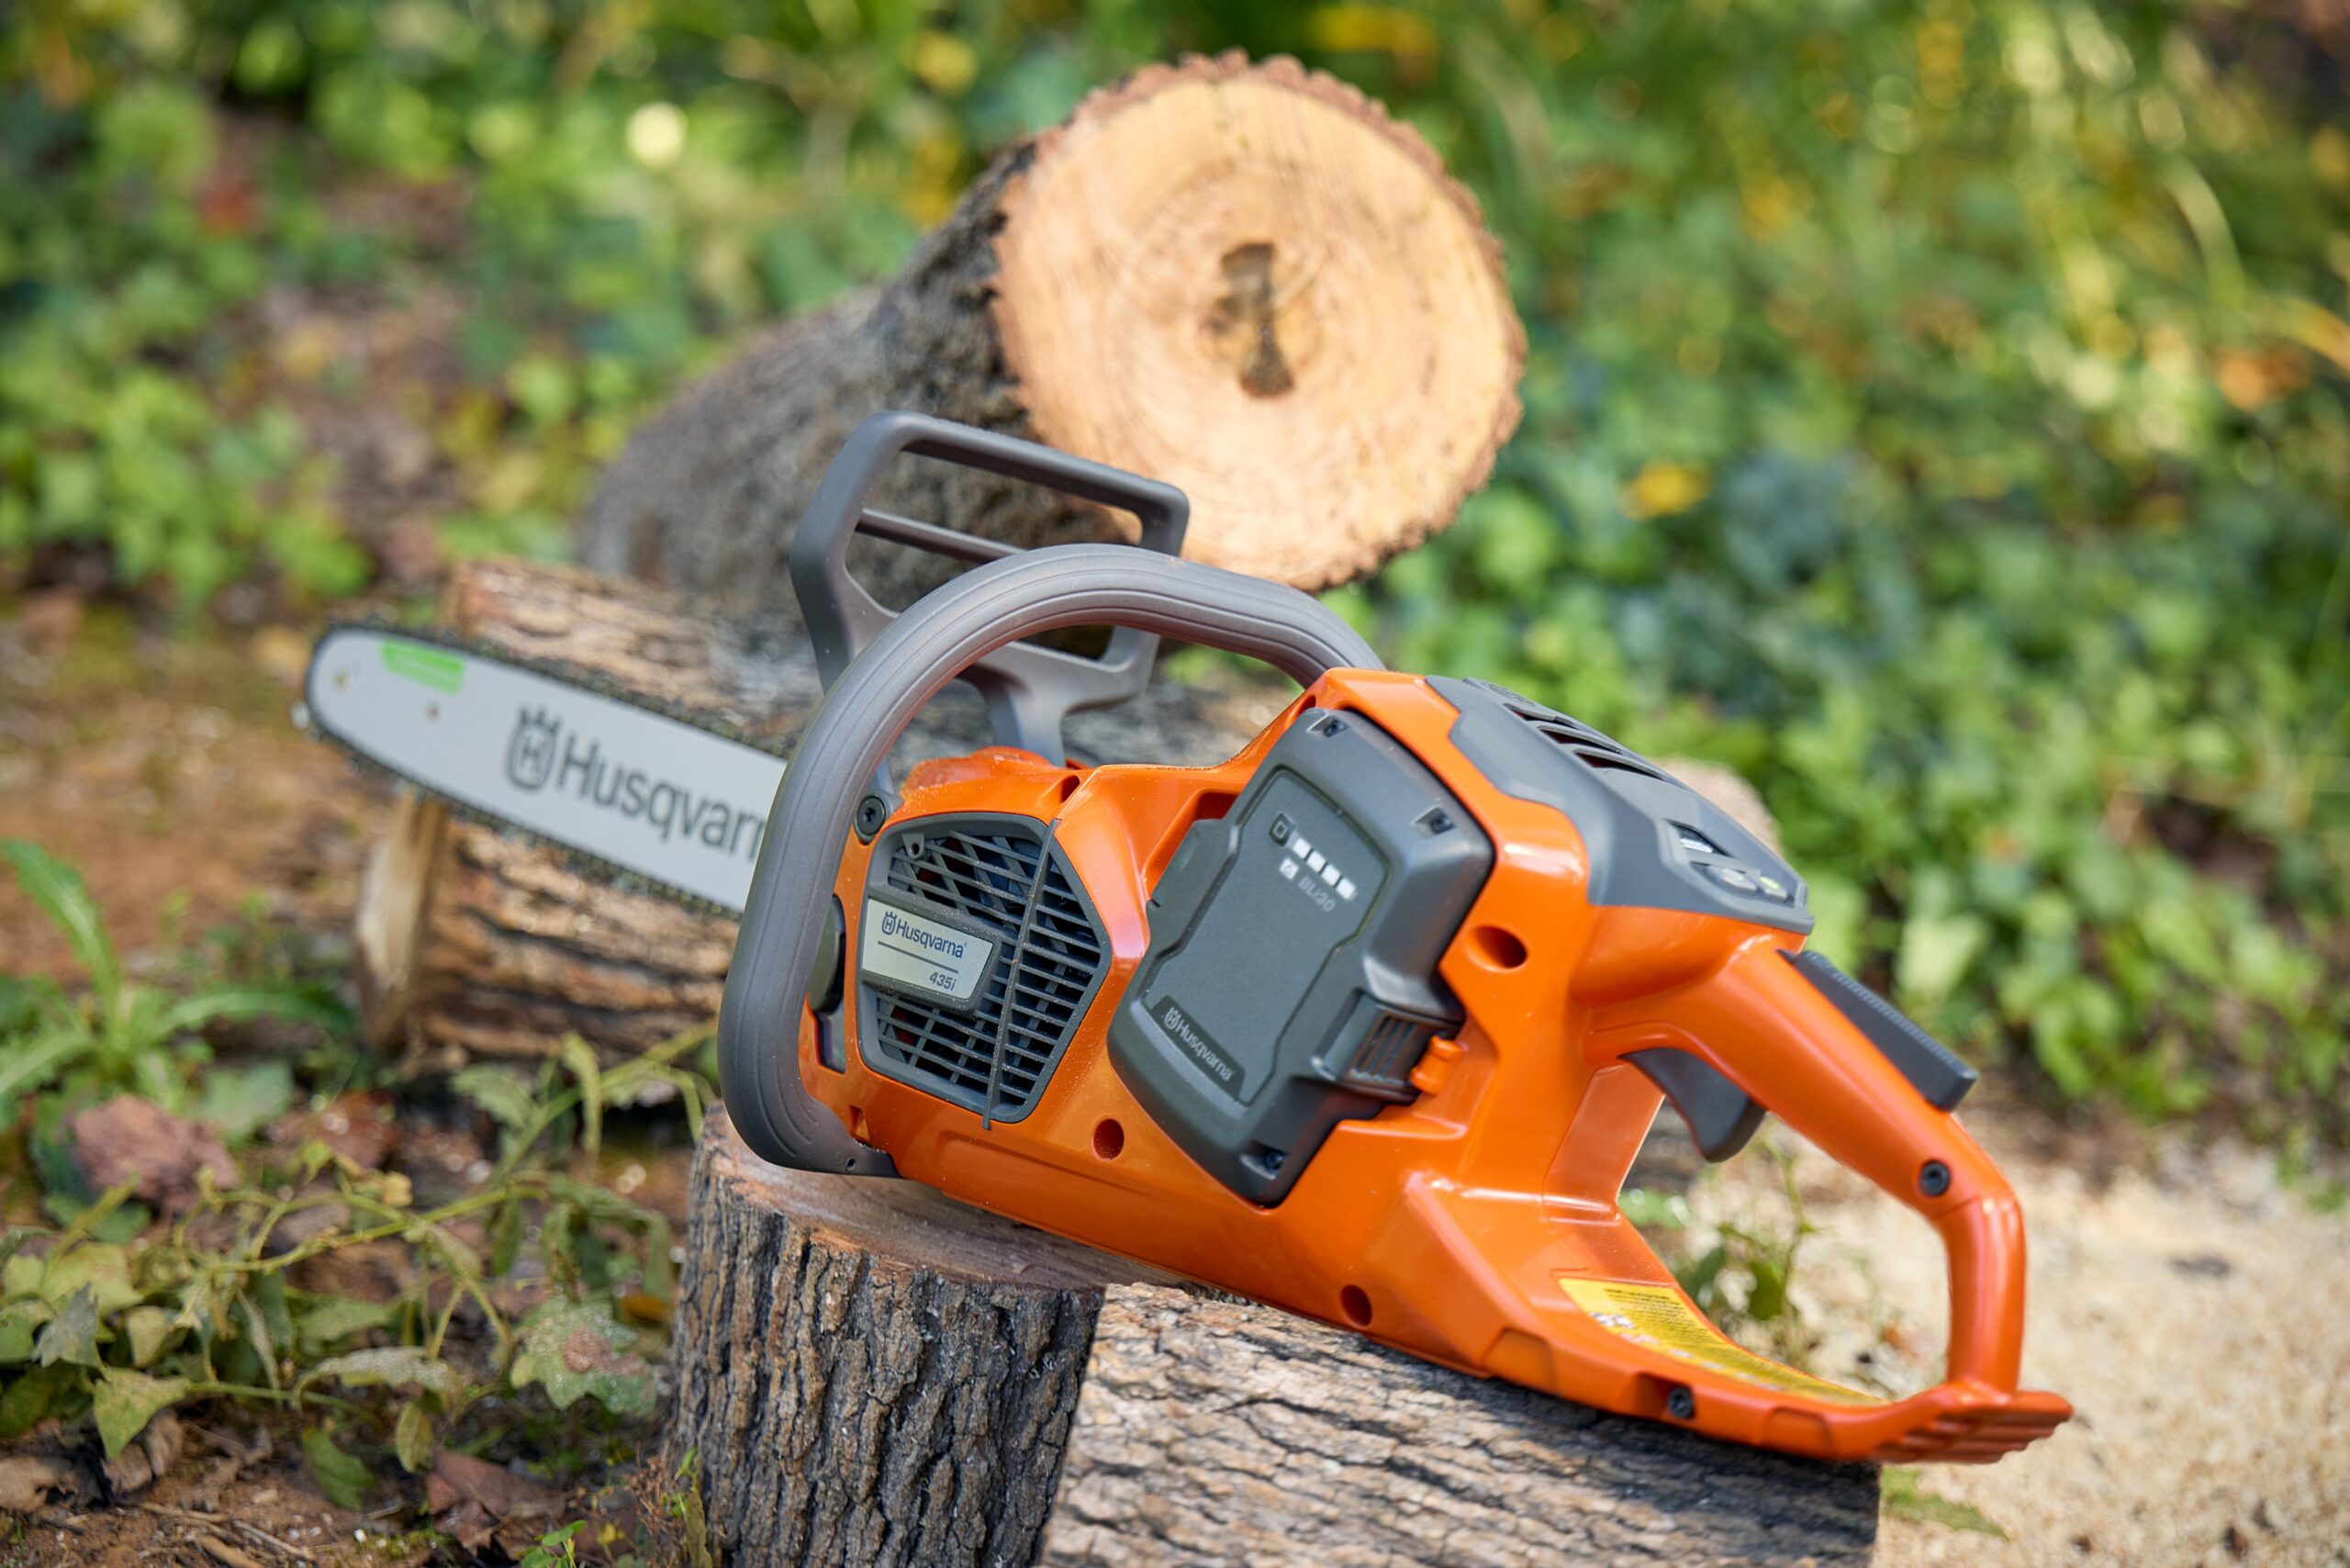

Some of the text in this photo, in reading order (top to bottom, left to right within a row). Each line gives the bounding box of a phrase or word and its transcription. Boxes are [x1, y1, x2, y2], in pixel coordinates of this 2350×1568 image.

[896, 919, 964, 958] Husqvarna
[929, 971, 957, 991] 435i
[1175, 1019, 1234, 1081] Husqvarna
